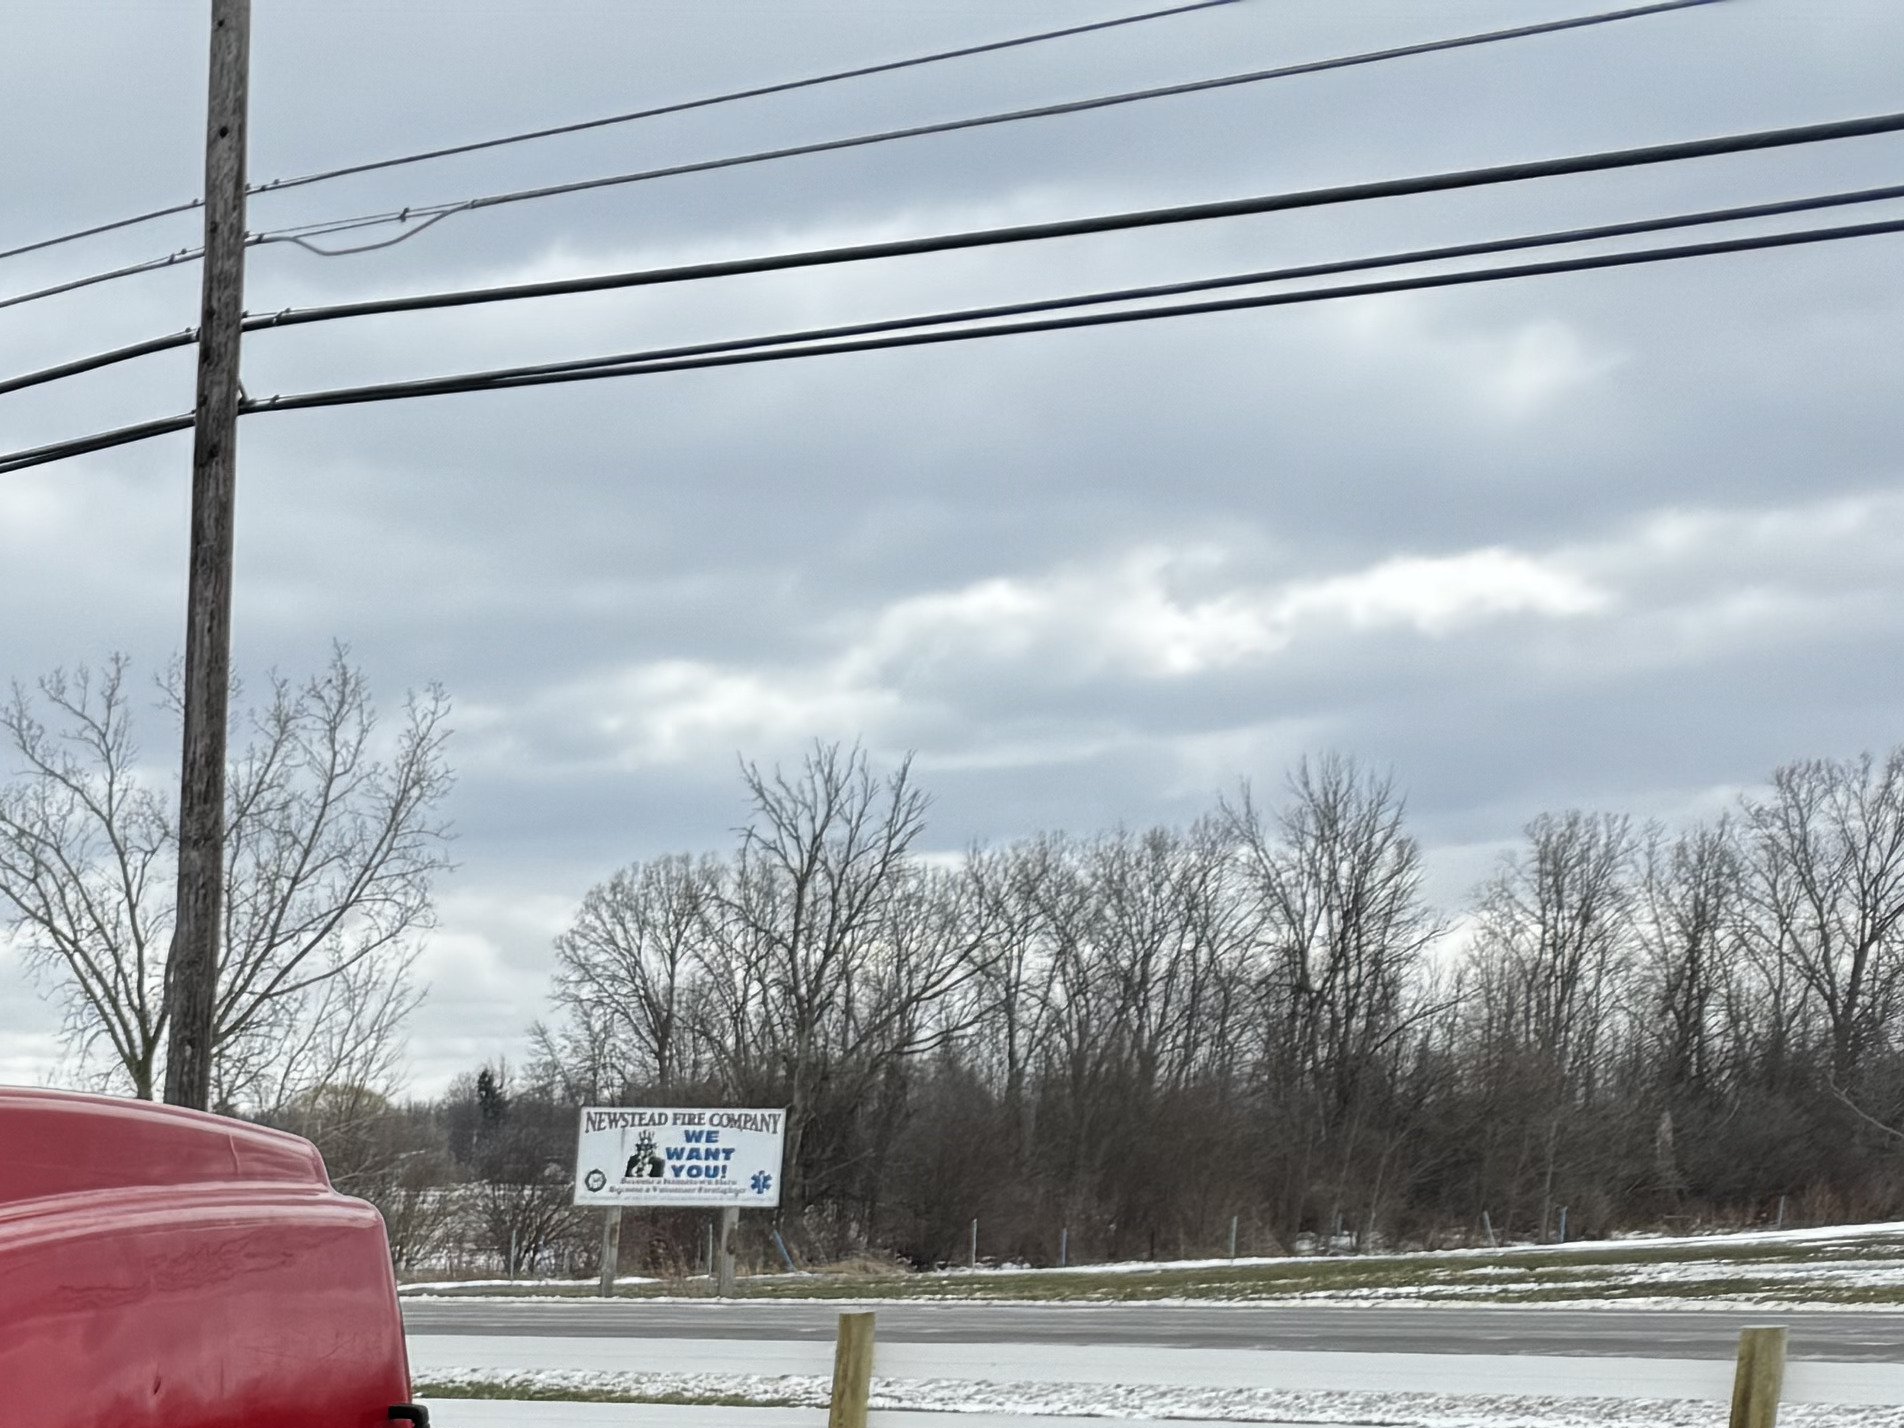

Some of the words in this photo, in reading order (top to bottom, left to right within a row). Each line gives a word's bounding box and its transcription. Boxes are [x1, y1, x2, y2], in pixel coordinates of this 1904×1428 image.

[585, 1111, 668, 1133] NEWSTEAD
[672, 1112, 706, 1126] FIRE
[709, 1112, 782, 1134] COMPANY
[684, 1130, 720, 1143] WE
[665, 1147, 736, 1161] WANT
[671, 1164, 728, 1179] YOU!
